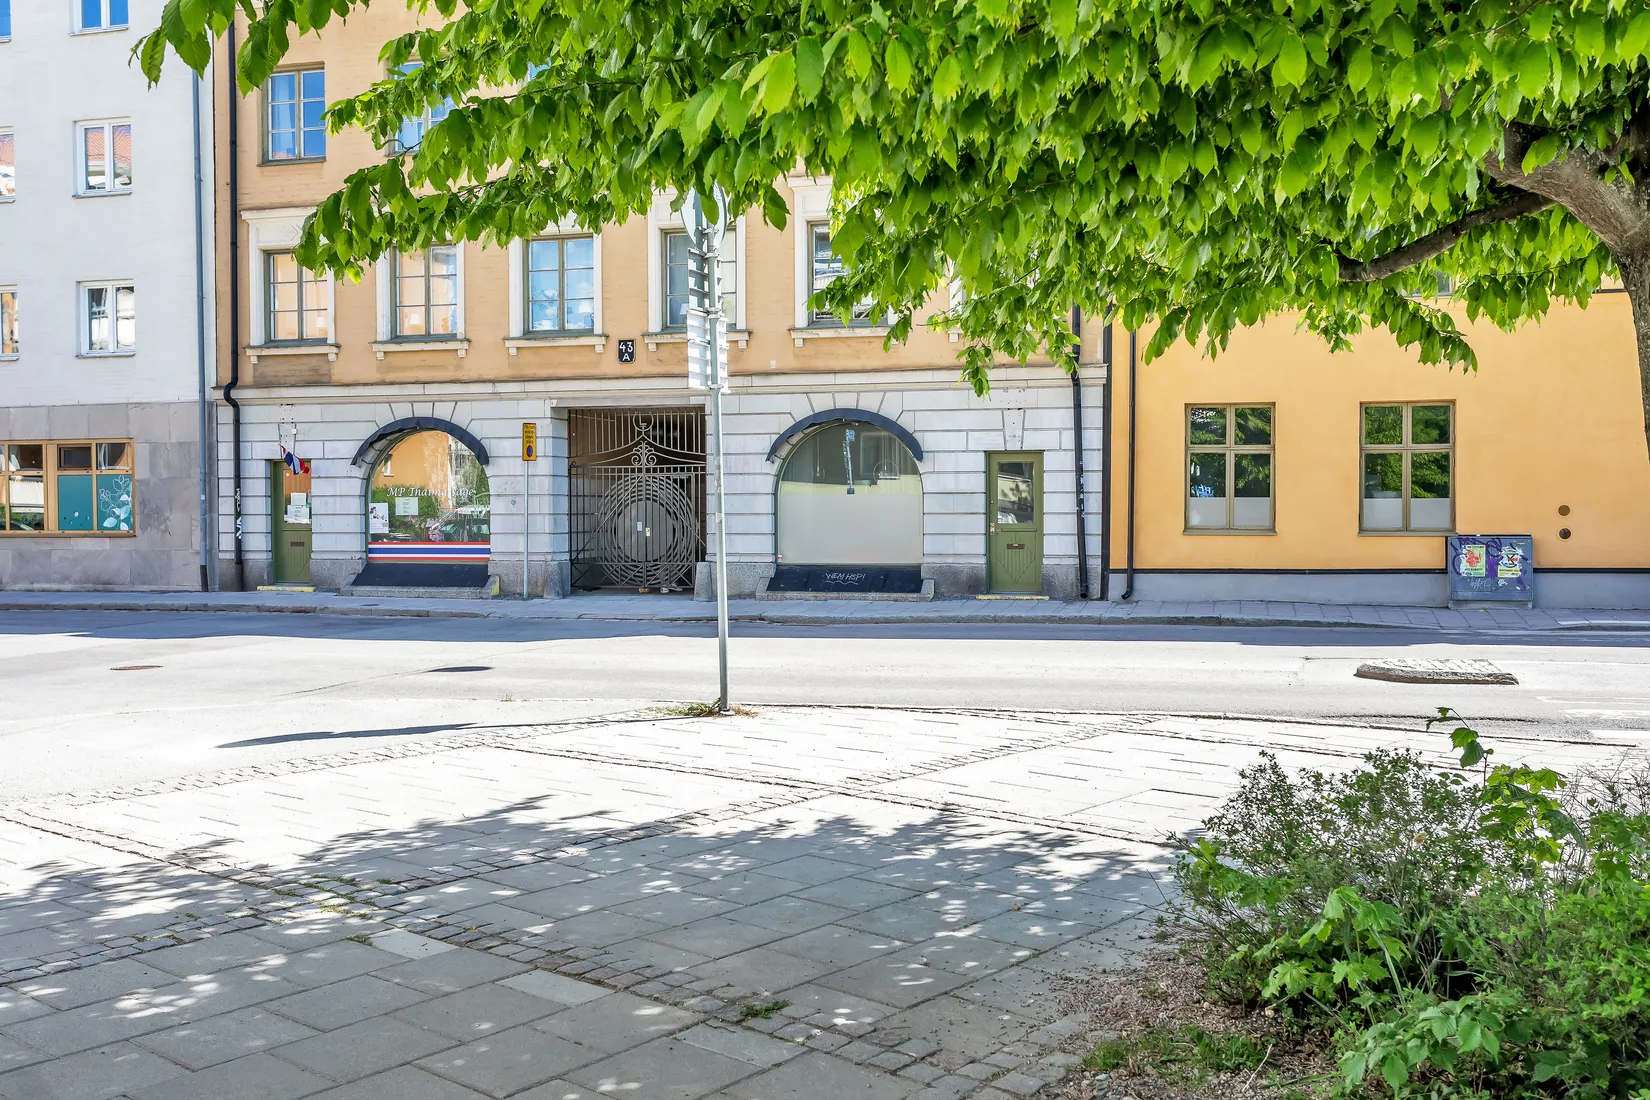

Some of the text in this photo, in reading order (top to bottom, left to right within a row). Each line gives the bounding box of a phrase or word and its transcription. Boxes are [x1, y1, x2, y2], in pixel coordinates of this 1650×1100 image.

[619, 342, 633, 352] 43
[622, 353, 631, 361] A
[387, 486, 474, 498] MP Thaimasage
